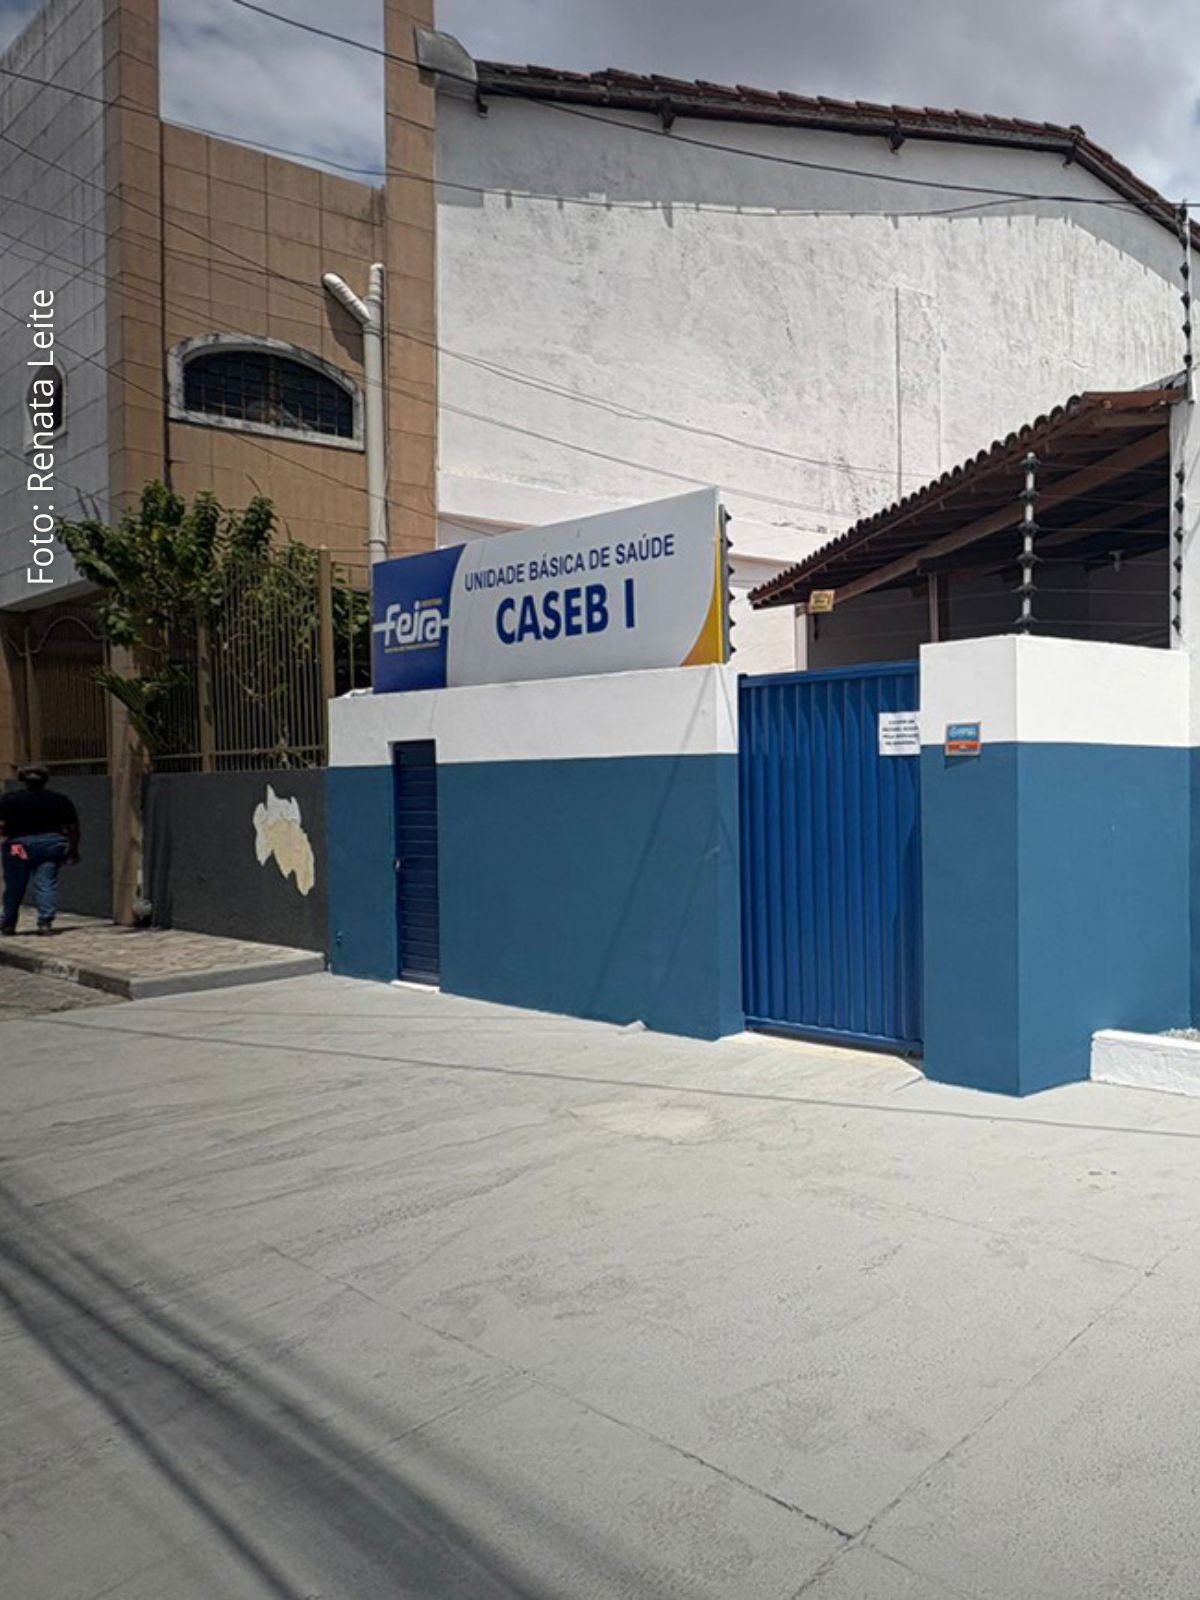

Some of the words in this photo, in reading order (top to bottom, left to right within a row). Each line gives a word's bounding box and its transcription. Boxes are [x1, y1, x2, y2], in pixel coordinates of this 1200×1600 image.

[465, 563, 525, 592] UNIDADE
[529, 551, 585, 581] BÁSICA
[589, 546, 610, 570] DE
[615, 533, 675, 566] SAÚDE
[496, 583, 609, 645] CASEB
[624, 578, 635, 629] I
